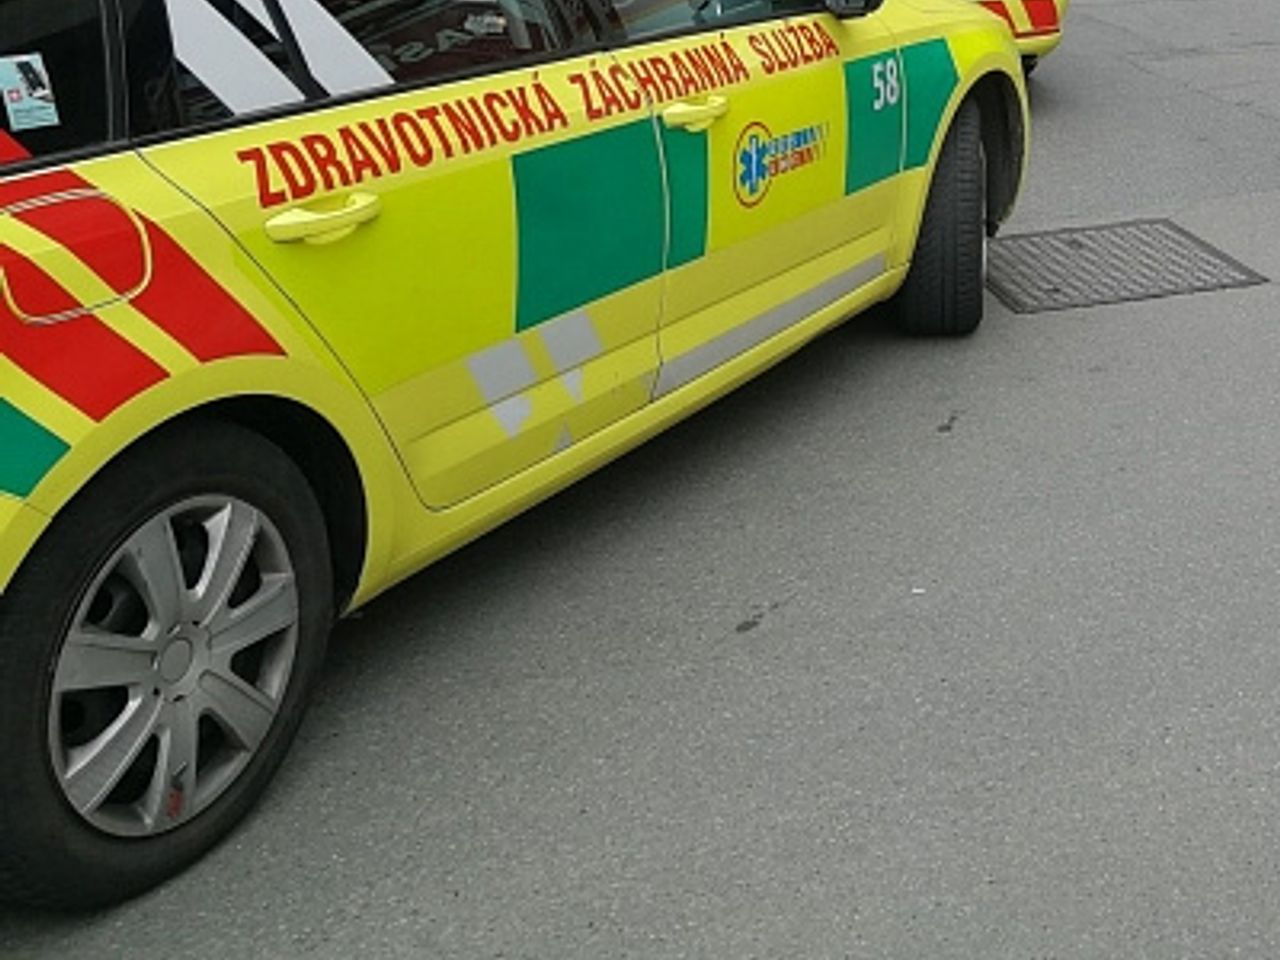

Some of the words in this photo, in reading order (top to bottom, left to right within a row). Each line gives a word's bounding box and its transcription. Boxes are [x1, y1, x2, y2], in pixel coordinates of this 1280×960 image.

[237, 71, 568, 208] ZDRAVOTNICKÁ
[568, 33, 750, 121] ZÁCHRANNÁ
[748, 19, 840, 75] SLUŽBA
[872, 57, 900, 111] 58
